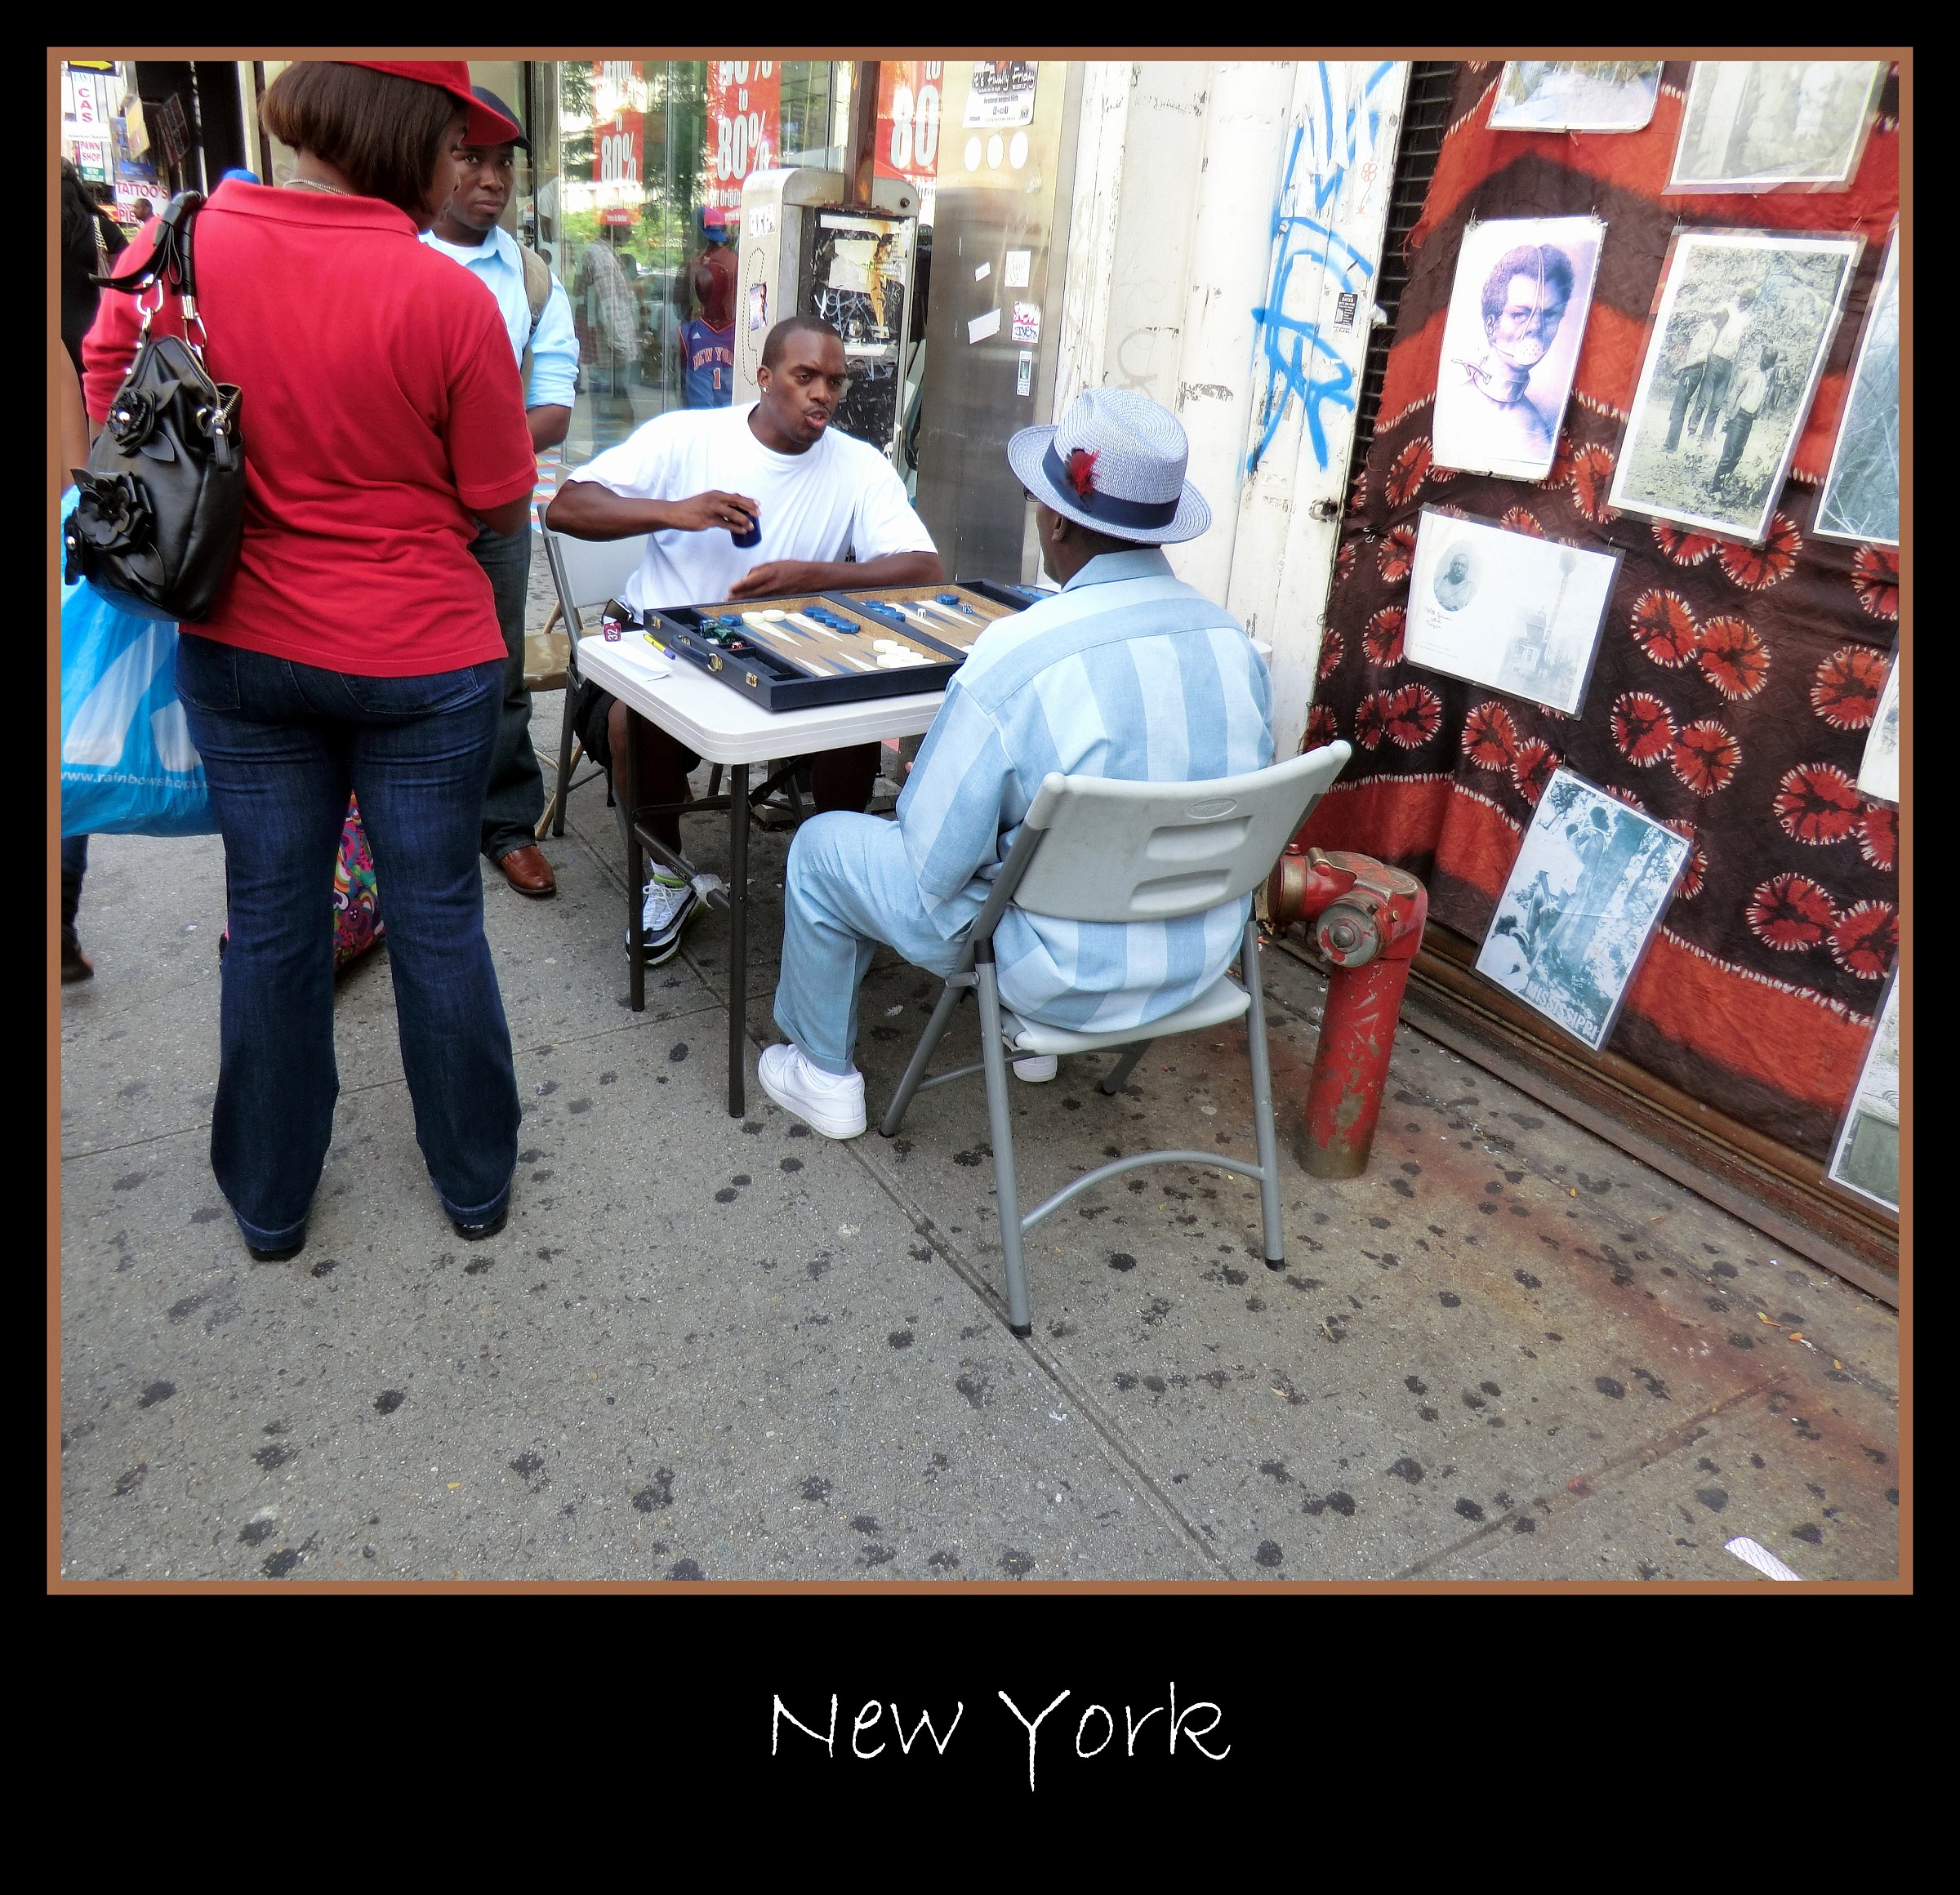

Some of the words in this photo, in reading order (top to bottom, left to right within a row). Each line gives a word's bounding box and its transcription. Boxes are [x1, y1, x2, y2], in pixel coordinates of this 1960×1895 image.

[1012, 66, 1036, 89] Friday
[738, 87, 749, 112] to
[890, 84, 939, 169] 80
[80, 140, 100, 151] PAWN
[82, 152, 101, 162] SHOP
[717, 110, 770, 181] 80%
[601, 131, 637, 184] 80%
[115, 181, 169, 200] TATTOO'S
[693, 347, 713, 371] NEW
[713, 367, 721, 389] 1
[607, 628, 618, 641] 32
